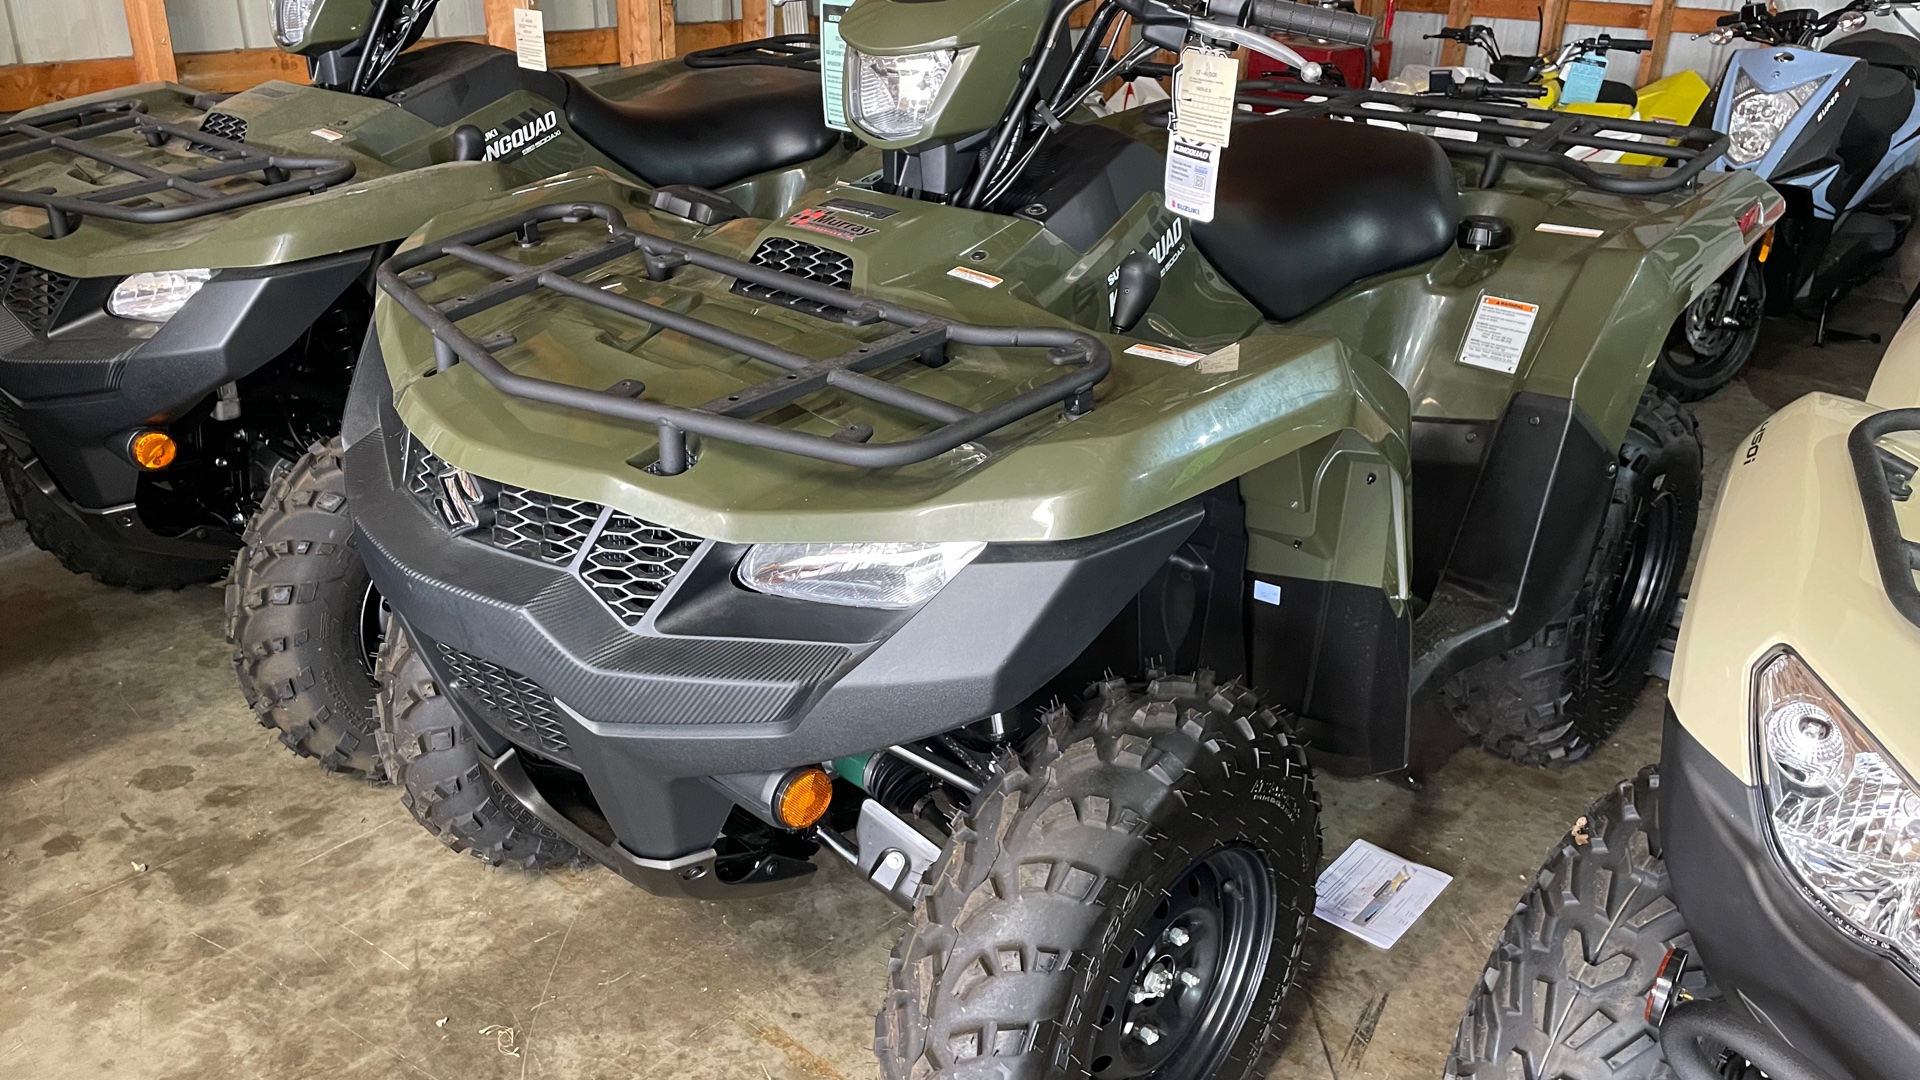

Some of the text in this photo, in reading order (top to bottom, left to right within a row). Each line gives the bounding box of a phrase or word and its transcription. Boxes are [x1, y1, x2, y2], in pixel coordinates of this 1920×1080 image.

[1816, 90, 1840, 122] SUPER
[481, 110, 557, 162] NGQUAD
[1176, 203, 1201, 216] SUZUKI
[813, 212, 876, 237] Murray
[1500, 301, 1524, 310] WARNING
[1801, 886, 1815, 898] DOT
